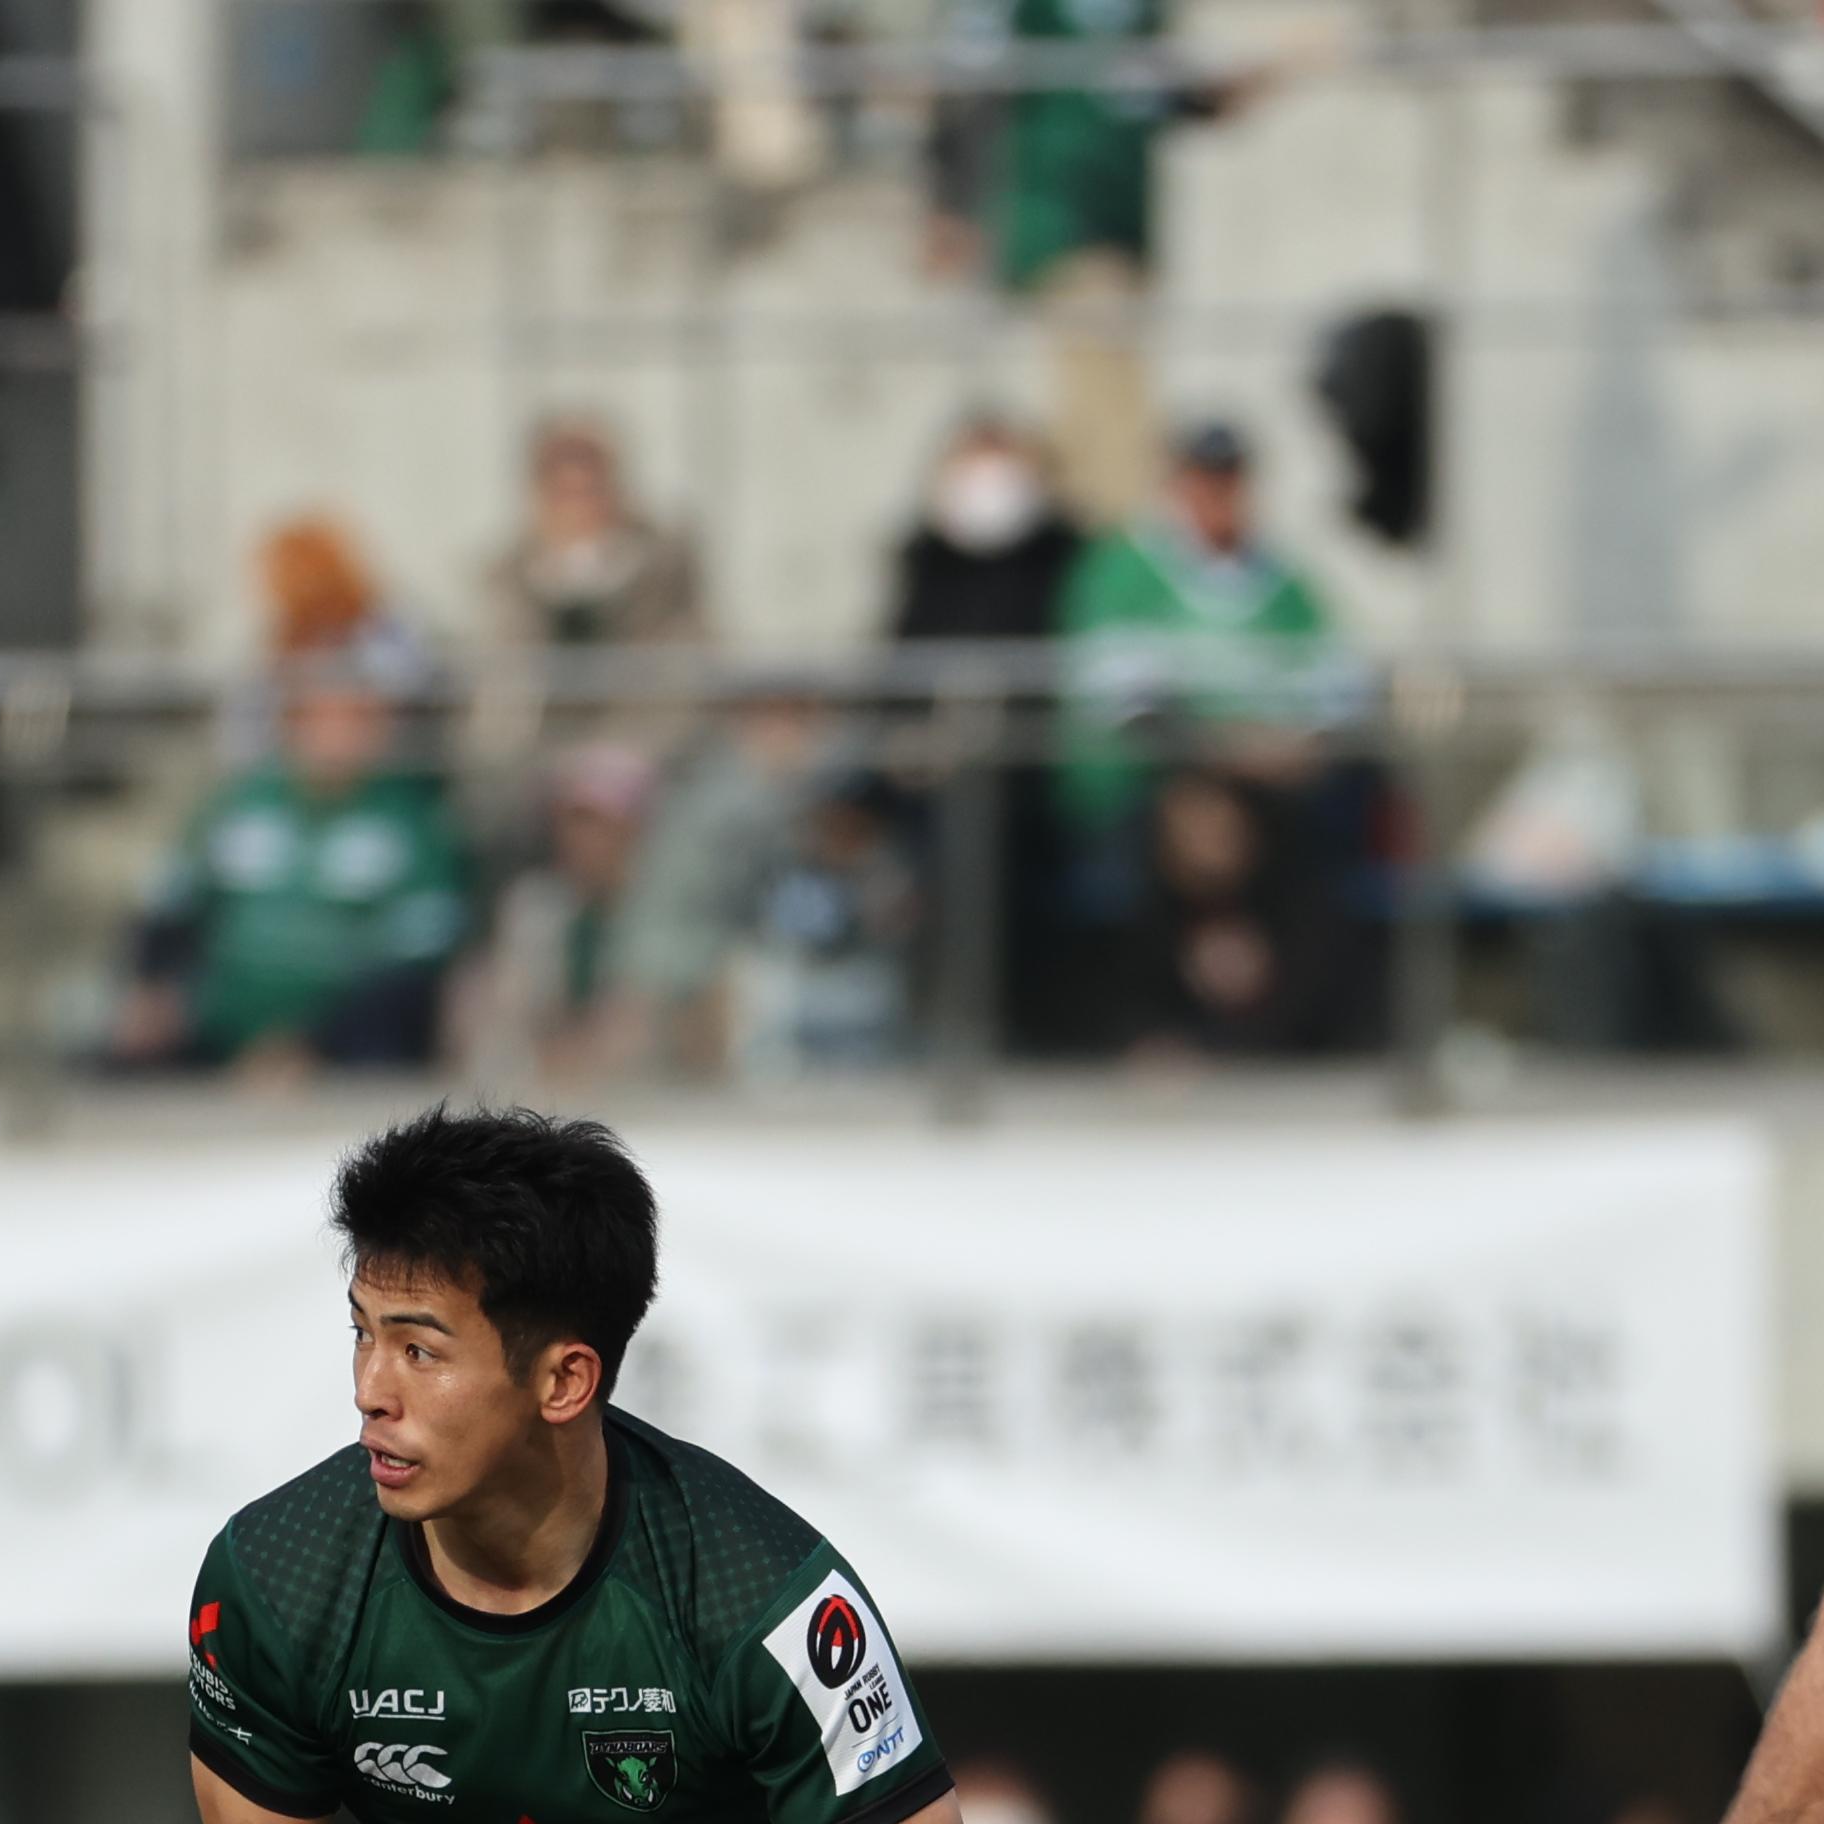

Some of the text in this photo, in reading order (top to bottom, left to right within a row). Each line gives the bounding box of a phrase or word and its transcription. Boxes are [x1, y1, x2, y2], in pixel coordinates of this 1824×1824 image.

[348, 1688, 446, 1720] UACJ
[592, 1686, 677, 1714] テクノ菱和
[848, 1681, 893, 1734] ONE
[876, 1726, 905, 1760] NTT
[362, 1777, 456, 1805] anterbury
